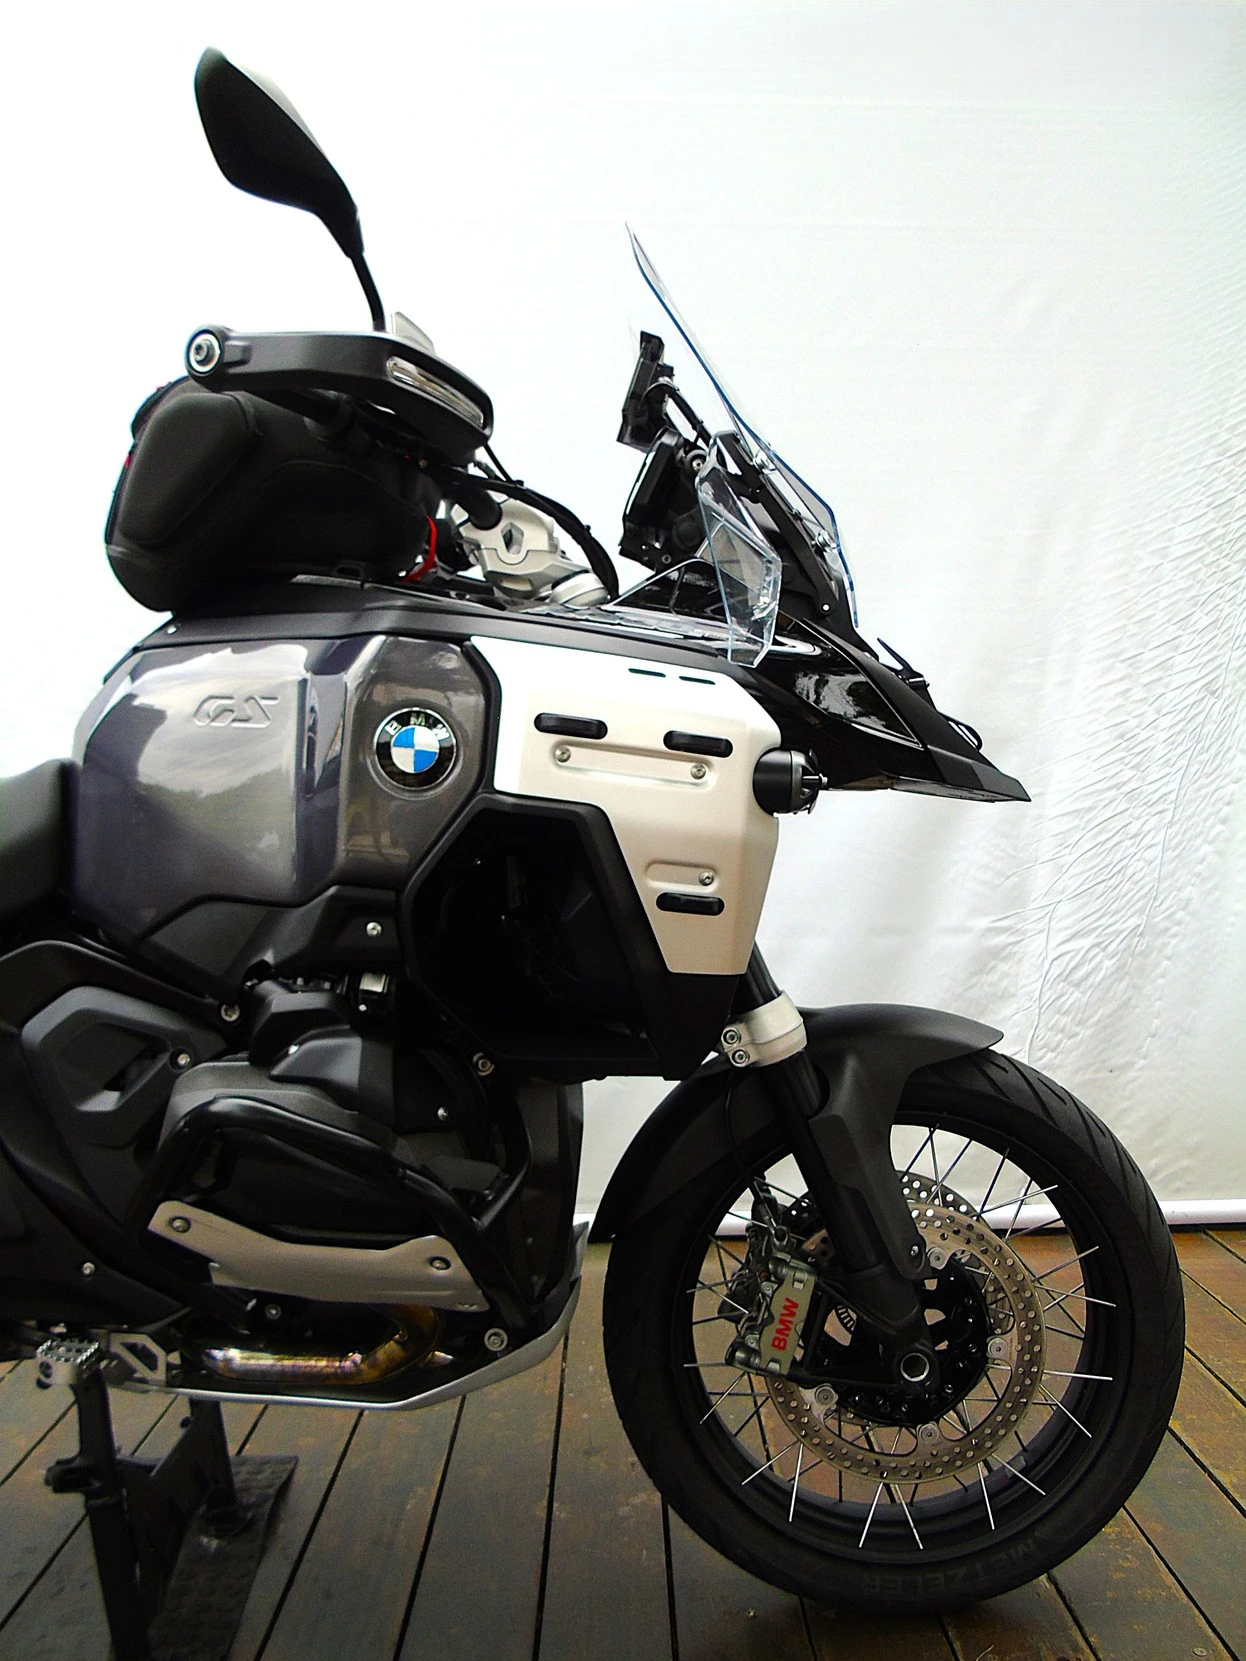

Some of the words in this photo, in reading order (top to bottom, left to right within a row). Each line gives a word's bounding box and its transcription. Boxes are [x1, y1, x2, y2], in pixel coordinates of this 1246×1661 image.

[193, 695, 280, 728] GS
[384, 713, 450, 740] BMW
[771, 1297, 799, 1351] BMW
[863, 1539, 1037, 1593] METZELER
